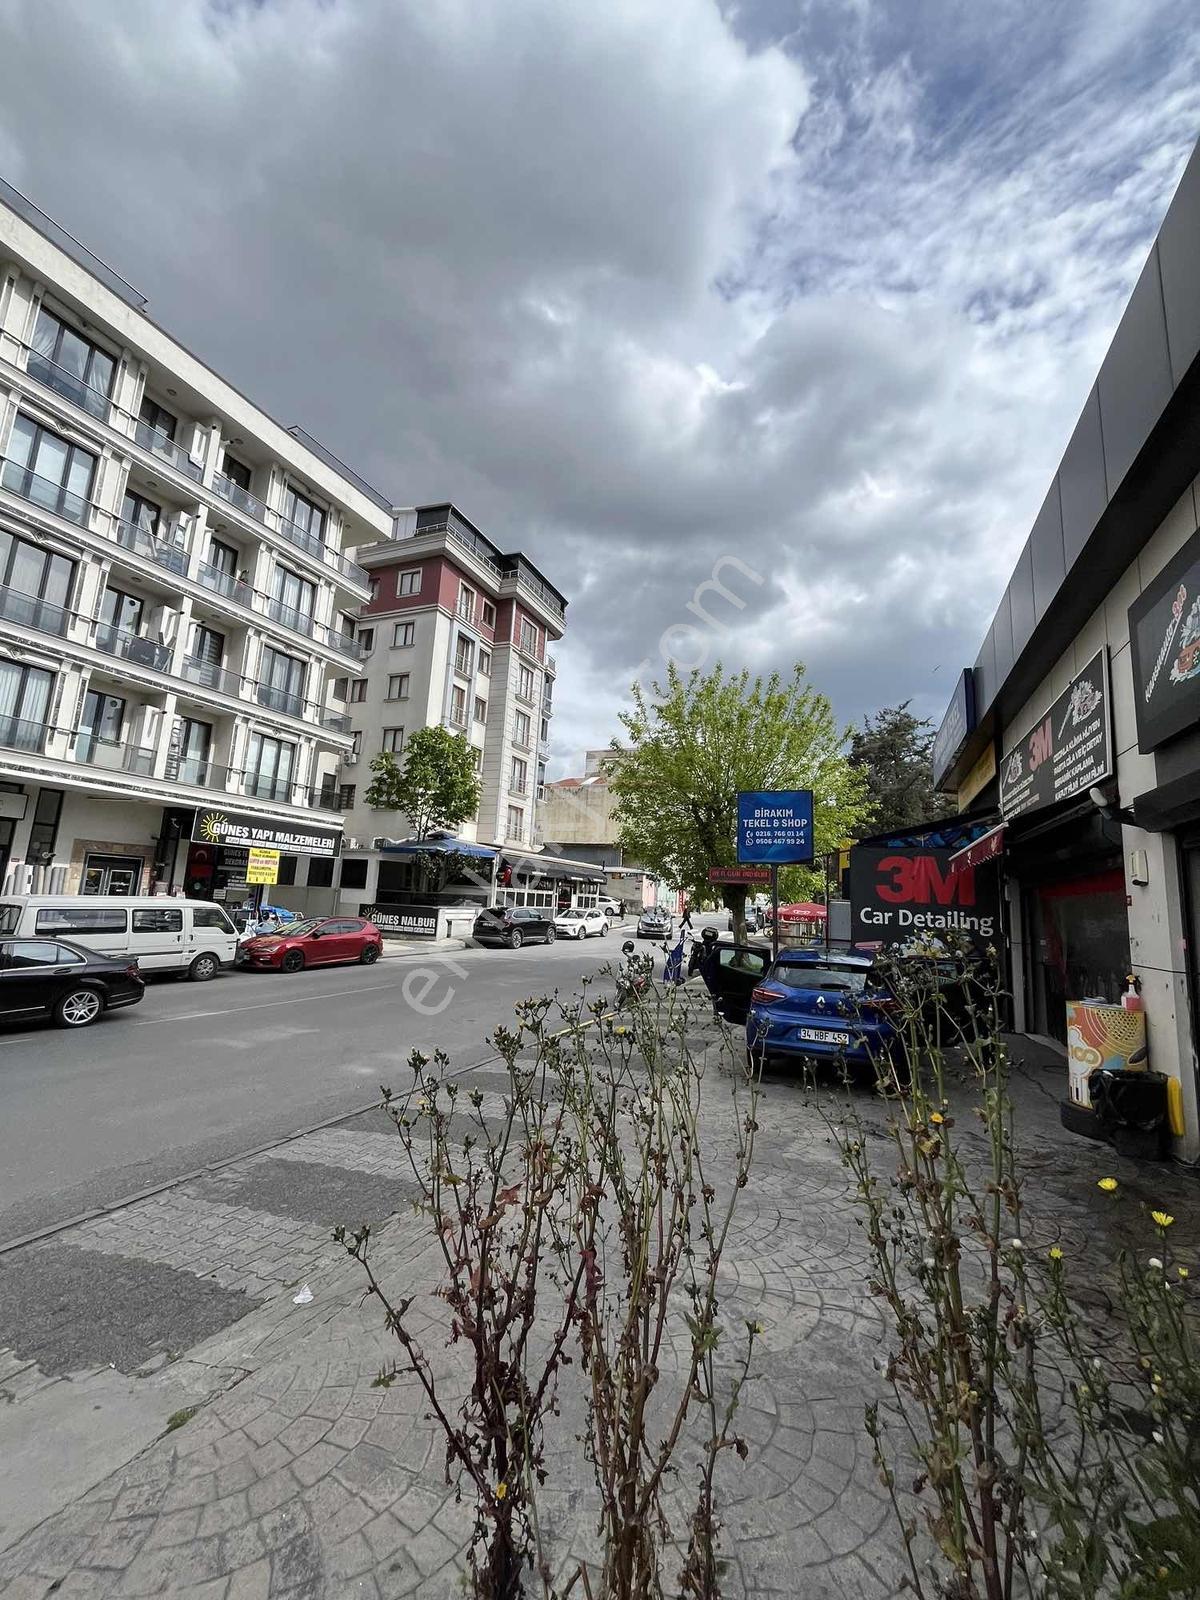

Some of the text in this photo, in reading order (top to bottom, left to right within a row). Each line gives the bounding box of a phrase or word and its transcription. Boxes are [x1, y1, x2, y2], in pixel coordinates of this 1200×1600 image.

[754, 807, 793, 818] BİRAKIM
[742, 819, 808, 828] TEKEL & SHOP
[212, 821, 249, 838] GÜNEŞ
[251, 828, 274, 841] YAPI
[275, 832, 335, 849] MALZEMELERİ
[875, 855, 976, 906] 3M
[371, 912, 436, 928] GÜNEŞ NALBUR
[860, 907, 994, 936] Car Detailing
[801, 1029, 811, 1039] 34
[814, 1031, 829, 1041] HBF
